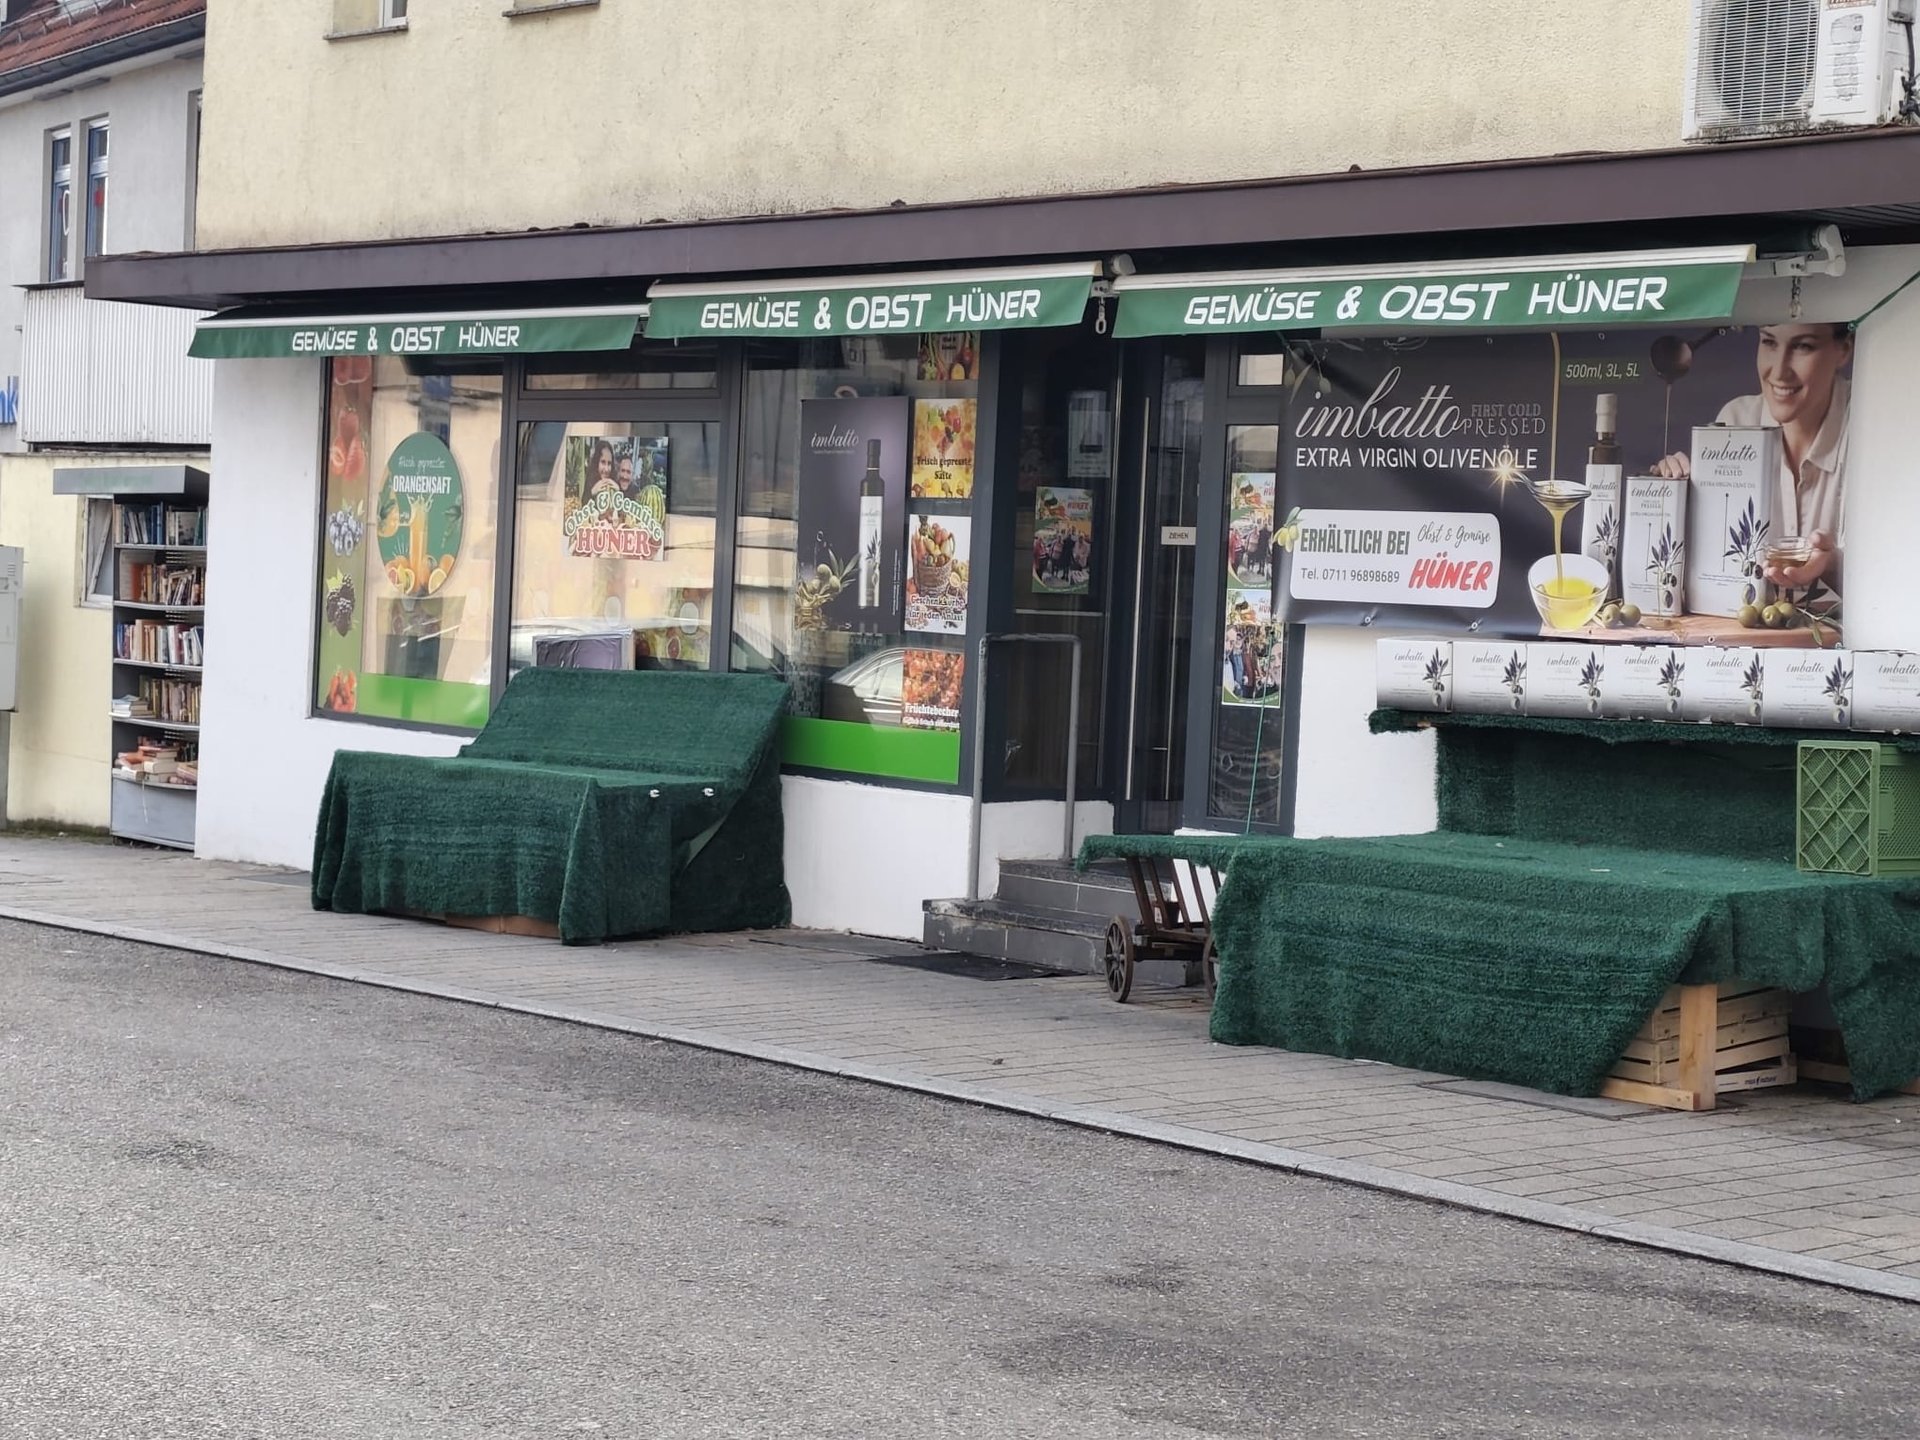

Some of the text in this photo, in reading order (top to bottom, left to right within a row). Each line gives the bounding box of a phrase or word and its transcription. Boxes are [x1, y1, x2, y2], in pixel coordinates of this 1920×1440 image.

[700, 287, 1042, 331] GEMÜSE & OBST HÜNER
[1184, 272, 1668, 325] GEMÜSE & OBST HÜNER
[292, 322, 520, 352] GEMÜSE & OBST HÜNER
[1565, 362, 1641, 379] 500ml, 3L, 5L
[1295, 366, 1464, 438] imbatto
[1471, 403, 1541, 417] FIRST COLD
[810, 424, 859, 449] imbatto
[1463, 417, 1546, 437] PRESSED
[1296, 444, 1539, 470] EXTRA VIRGIN OLIVENÖLE
[1701, 440, 1757, 461] imbatto
[393, 474, 452, 495] ORANGENSAFT
[1631, 482, 1673, 498] imbatto
[565, 500, 596, 536] Obst
[613, 491, 662, 541] Gemüse
[575, 520, 650, 556] HÜNER
[1300, 524, 1410, 556] ERHÄLTLICH BEI
[1417, 520, 1444, 543] Obst
[1455, 525, 1491, 548] Gemüse
[1301, 567, 1400, 583] Tel. 0711 96898689
[1408, 551, 1494, 592] HÜNER
